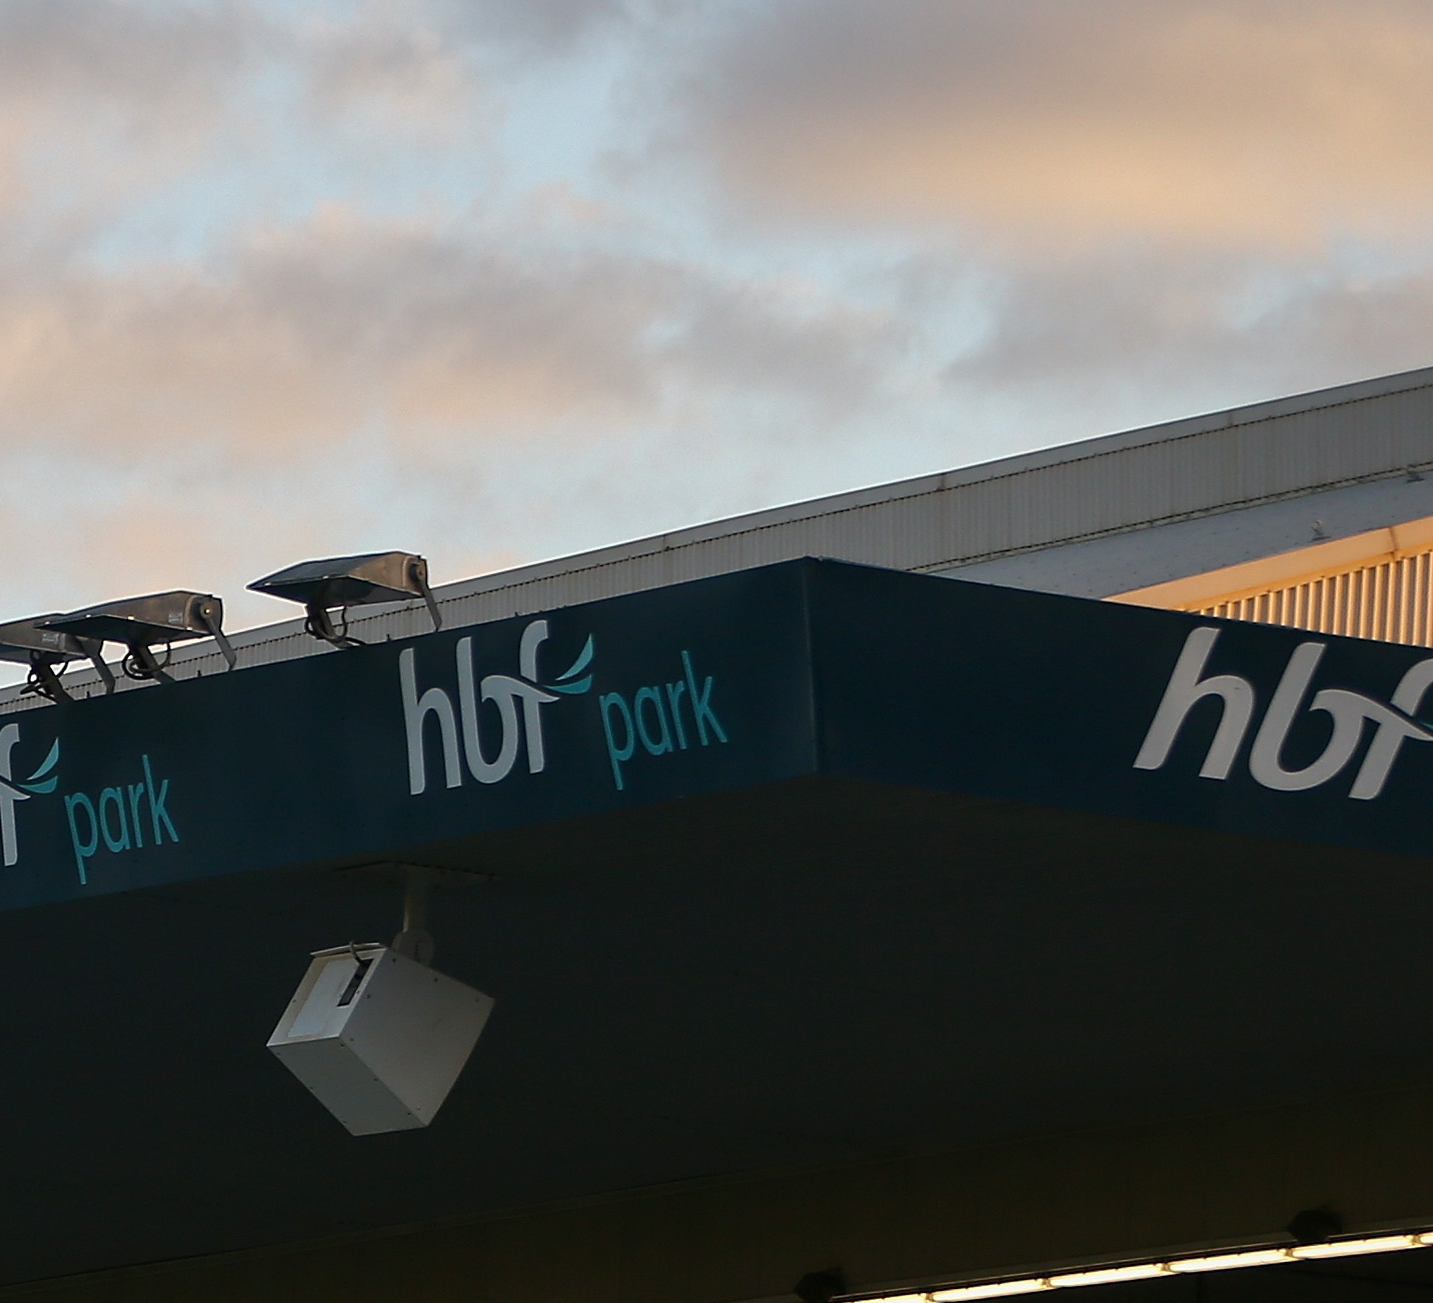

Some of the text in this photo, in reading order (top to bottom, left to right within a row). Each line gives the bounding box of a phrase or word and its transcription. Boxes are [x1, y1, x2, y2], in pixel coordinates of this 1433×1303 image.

[399, 620, 727, 795] hbf park
[65, 755, 179, 884] park
